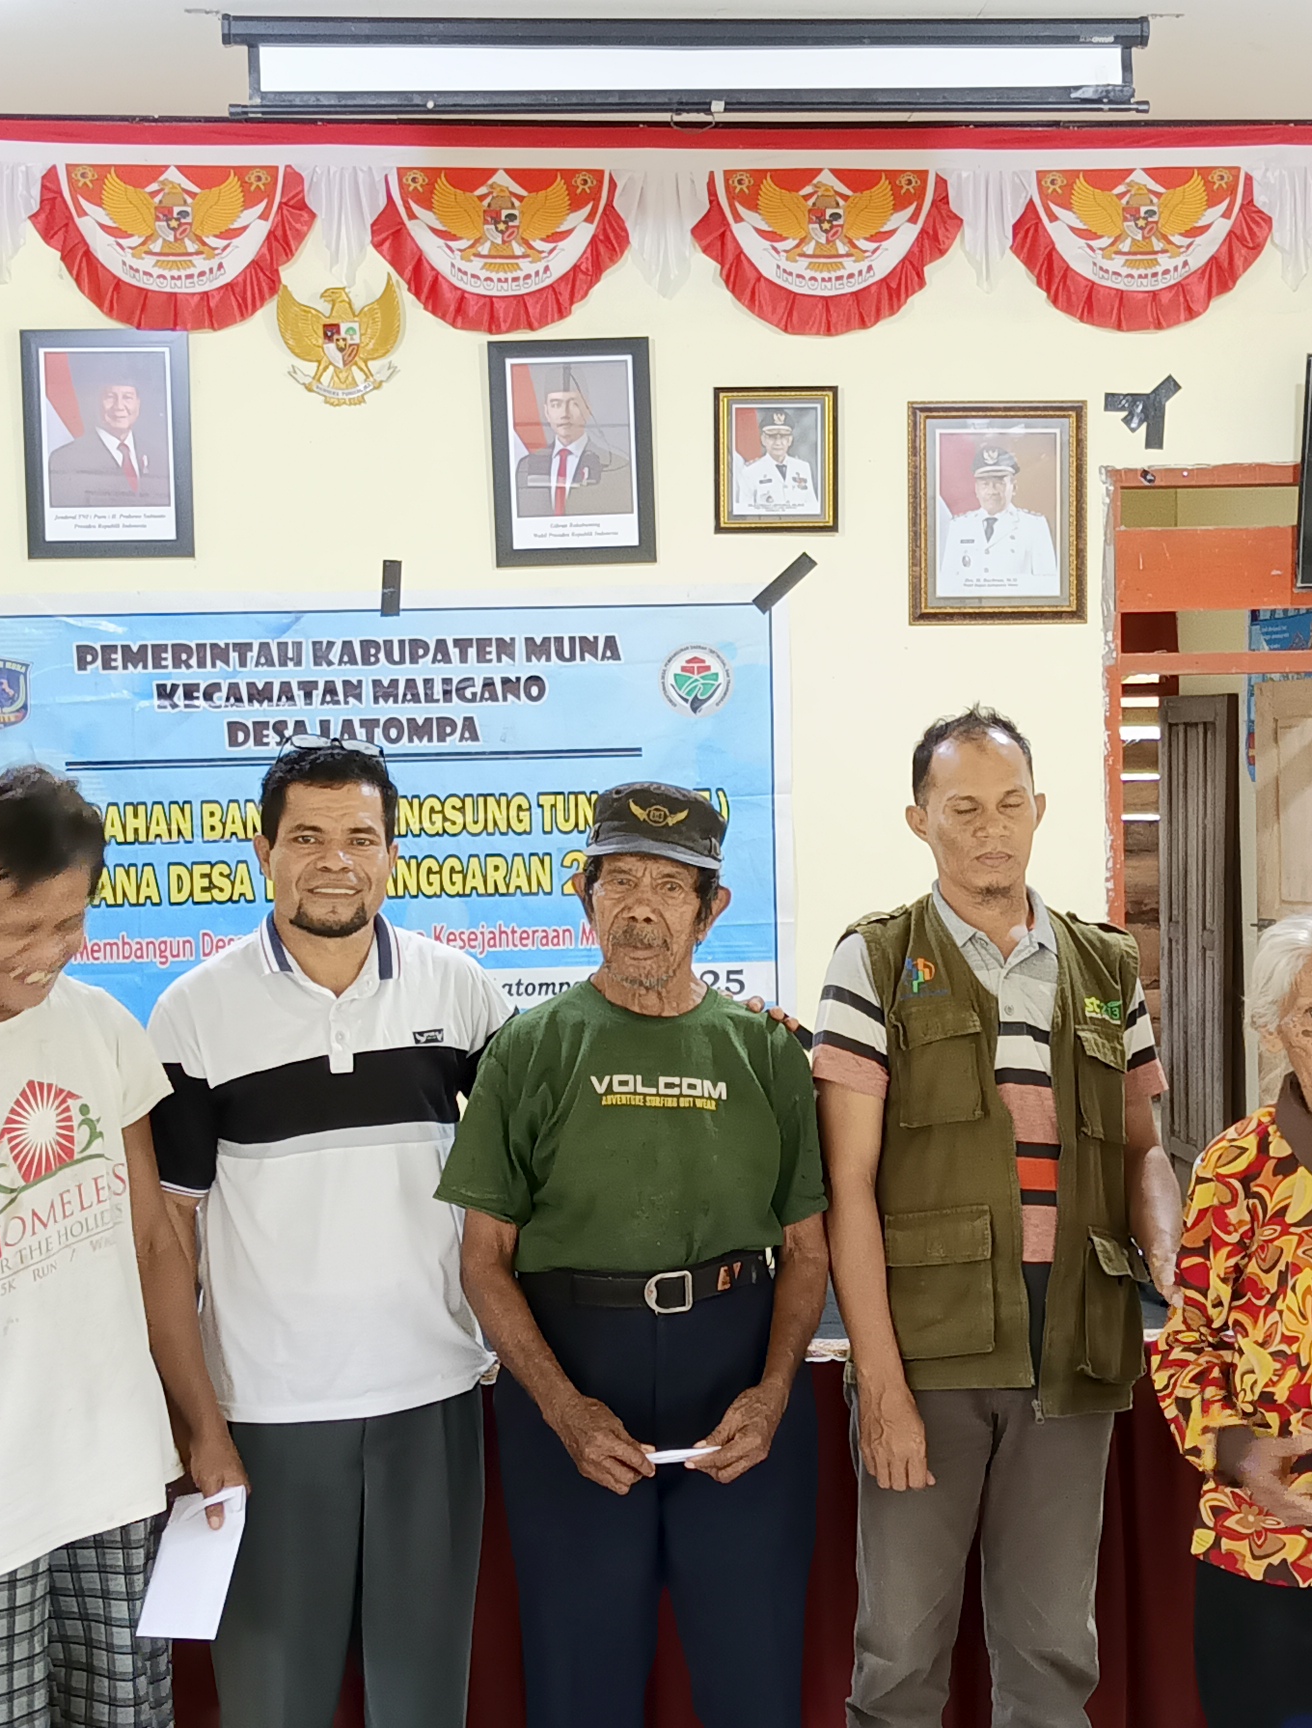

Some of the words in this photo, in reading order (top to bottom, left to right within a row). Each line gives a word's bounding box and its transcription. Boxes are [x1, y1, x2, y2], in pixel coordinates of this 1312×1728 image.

[121, 259, 228, 290] INDONESIA
[450, 262, 553, 292] INDONESIA
[776, 262, 875, 292] INDONESIA
[1091, 259, 1189, 288] INDONESIA
[74, 640, 304, 673] PEMERINTAH
[311, 637, 517, 668] KABUPATEN
[523, 634, 622, 664] MUNA
[154, 678, 364, 711] KECAMATAN
[371, 674, 547, 706] MALIGANO
[226, 718, 308, 748] DESA
[92, 800, 193, 846] AHAN
[200, 799, 263, 844] BAN
[394, 793, 532, 837] NGSUNG
[537, 791, 599, 835] TUN
[90, 860, 162, 908] ANA
[168, 859, 256, 906] DESA
[433, 922, 574, 956] Kesejahteraan
[590, 1074, 728, 1100] VOLCOM
[601, 1094, 645, 1106] ADVENTURE
[694, 1098, 717, 1111] WEAR
[17, 1235, 55, 1265] THE
[32, 1260, 58, 1283] RUN
